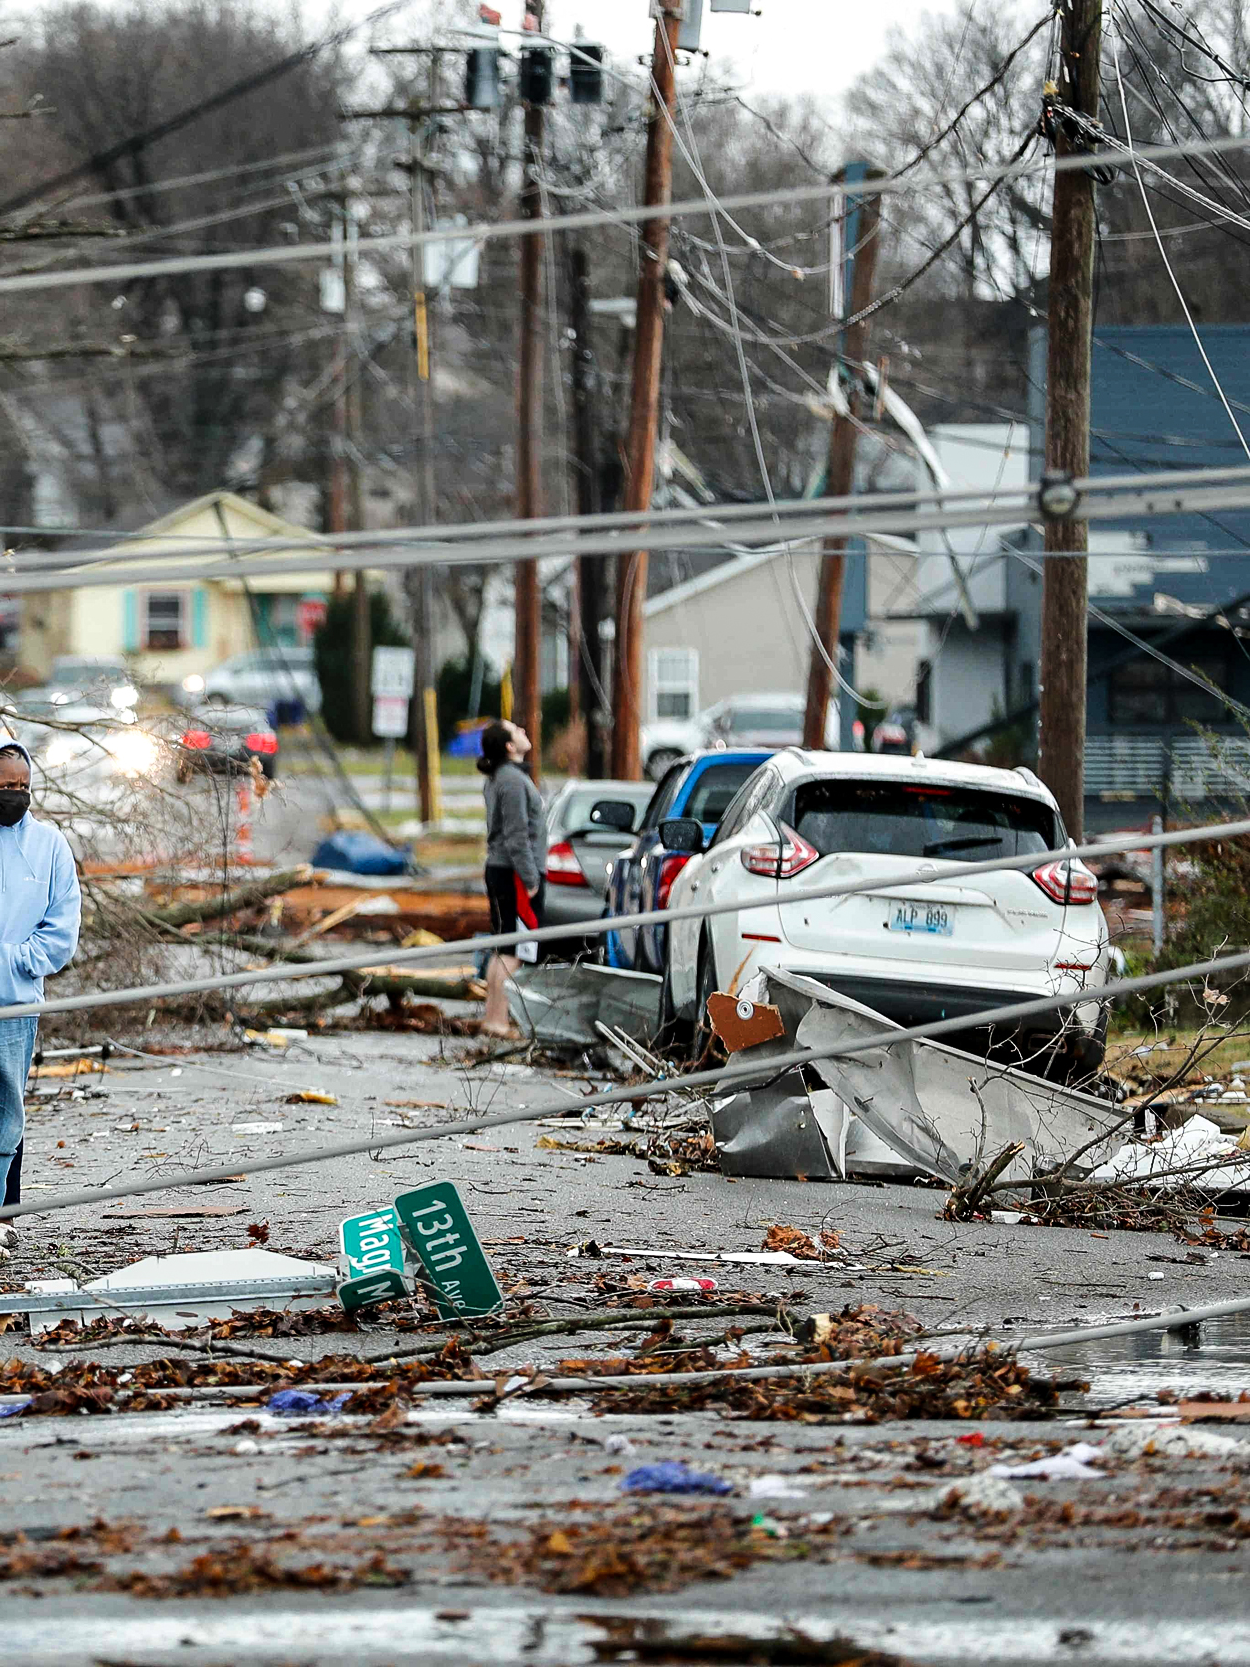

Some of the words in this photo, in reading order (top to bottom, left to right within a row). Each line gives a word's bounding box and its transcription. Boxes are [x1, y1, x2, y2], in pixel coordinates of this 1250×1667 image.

[896, 907, 918, 924] ALP
[411, 1199, 468, 1273] 13th
[441, 1280, 467, 1309] Ave
